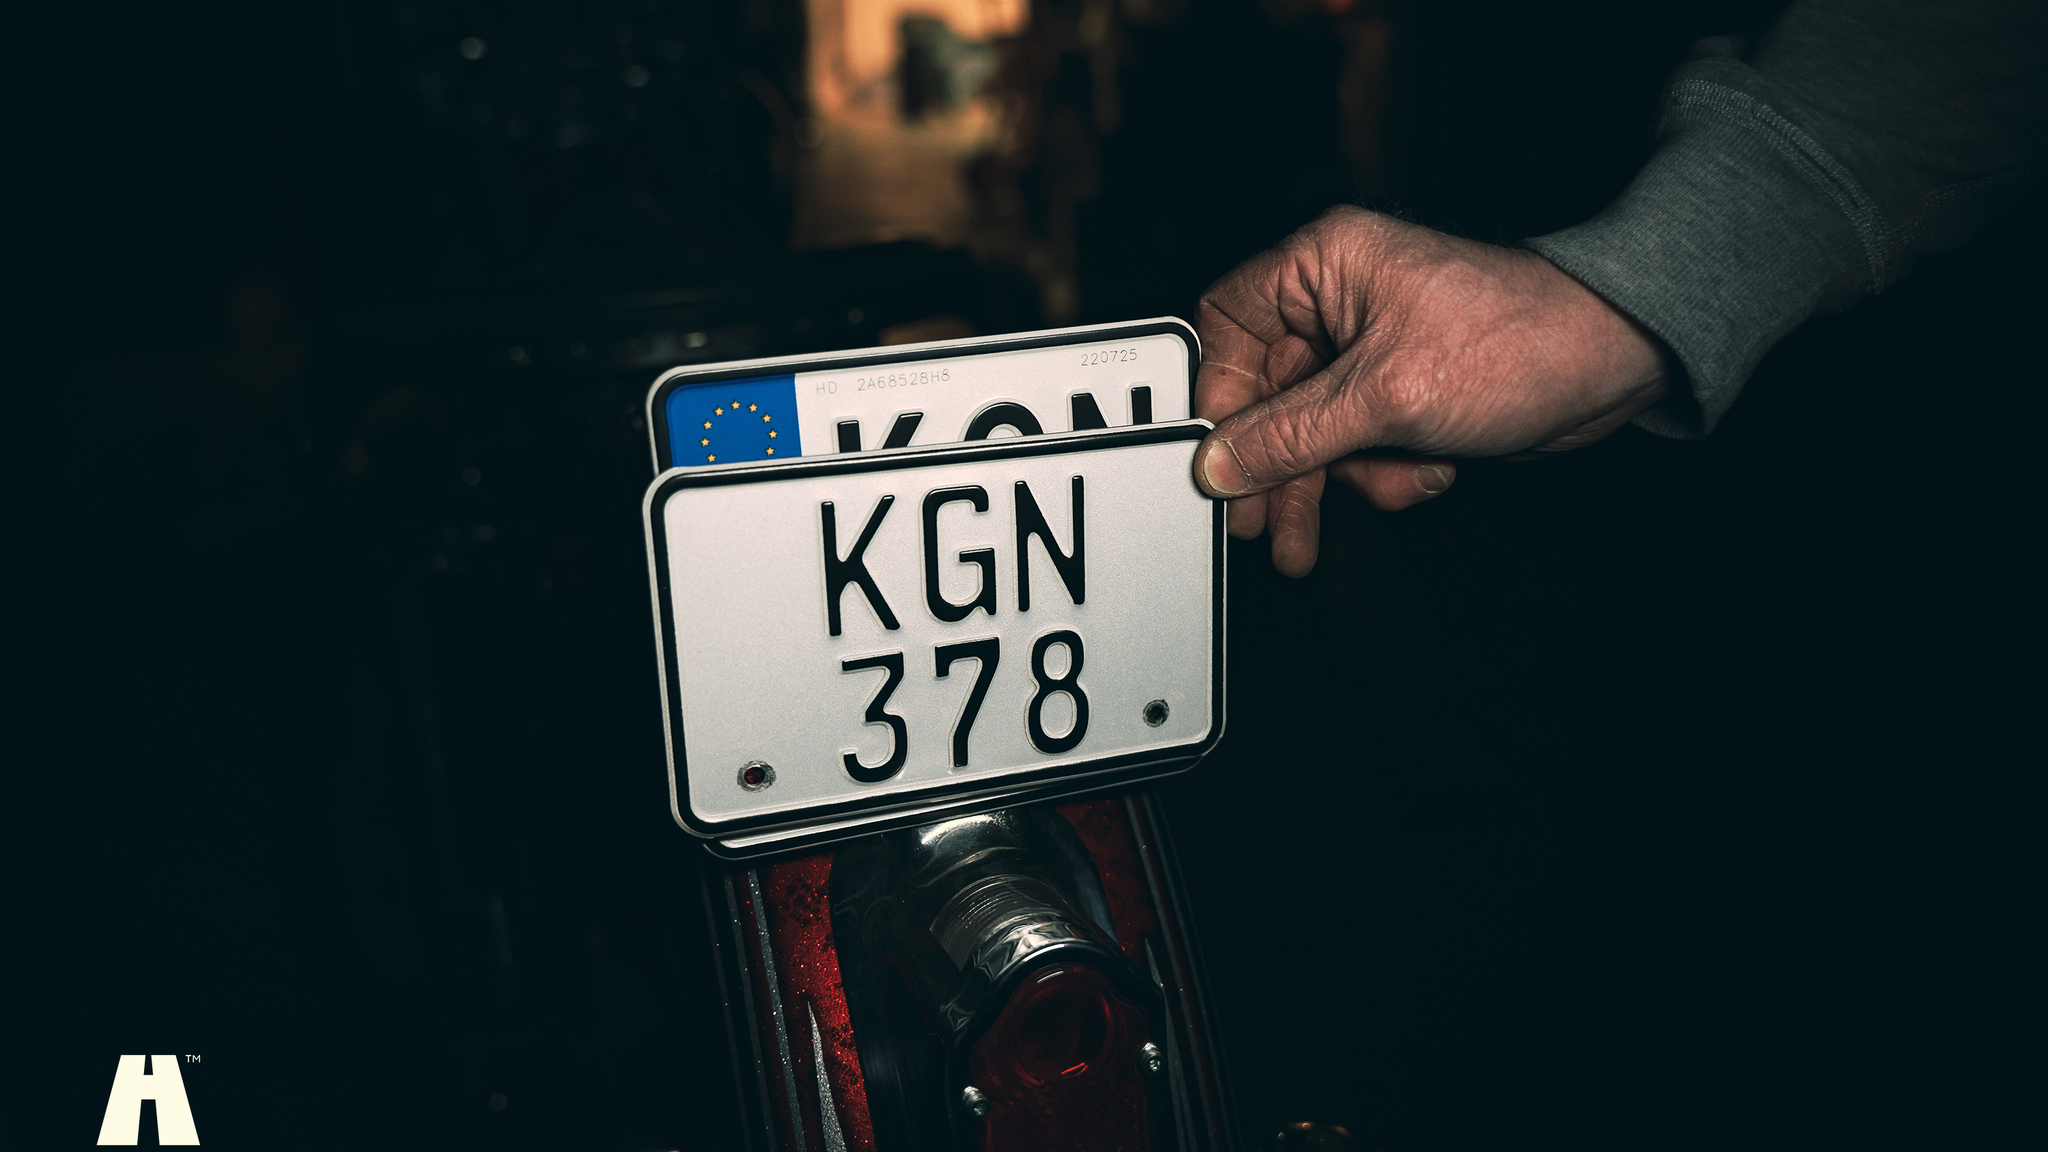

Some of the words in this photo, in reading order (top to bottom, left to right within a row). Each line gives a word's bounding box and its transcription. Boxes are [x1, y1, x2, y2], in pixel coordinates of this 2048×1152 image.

[815, 380, 838, 396] HD
[857, 368, 951, 392] 2A68528H8
[1080, 348, 1138, 367] 220725
[821, 475, 1086, 637] KGN
[841, 630, 1090, 783] 378
